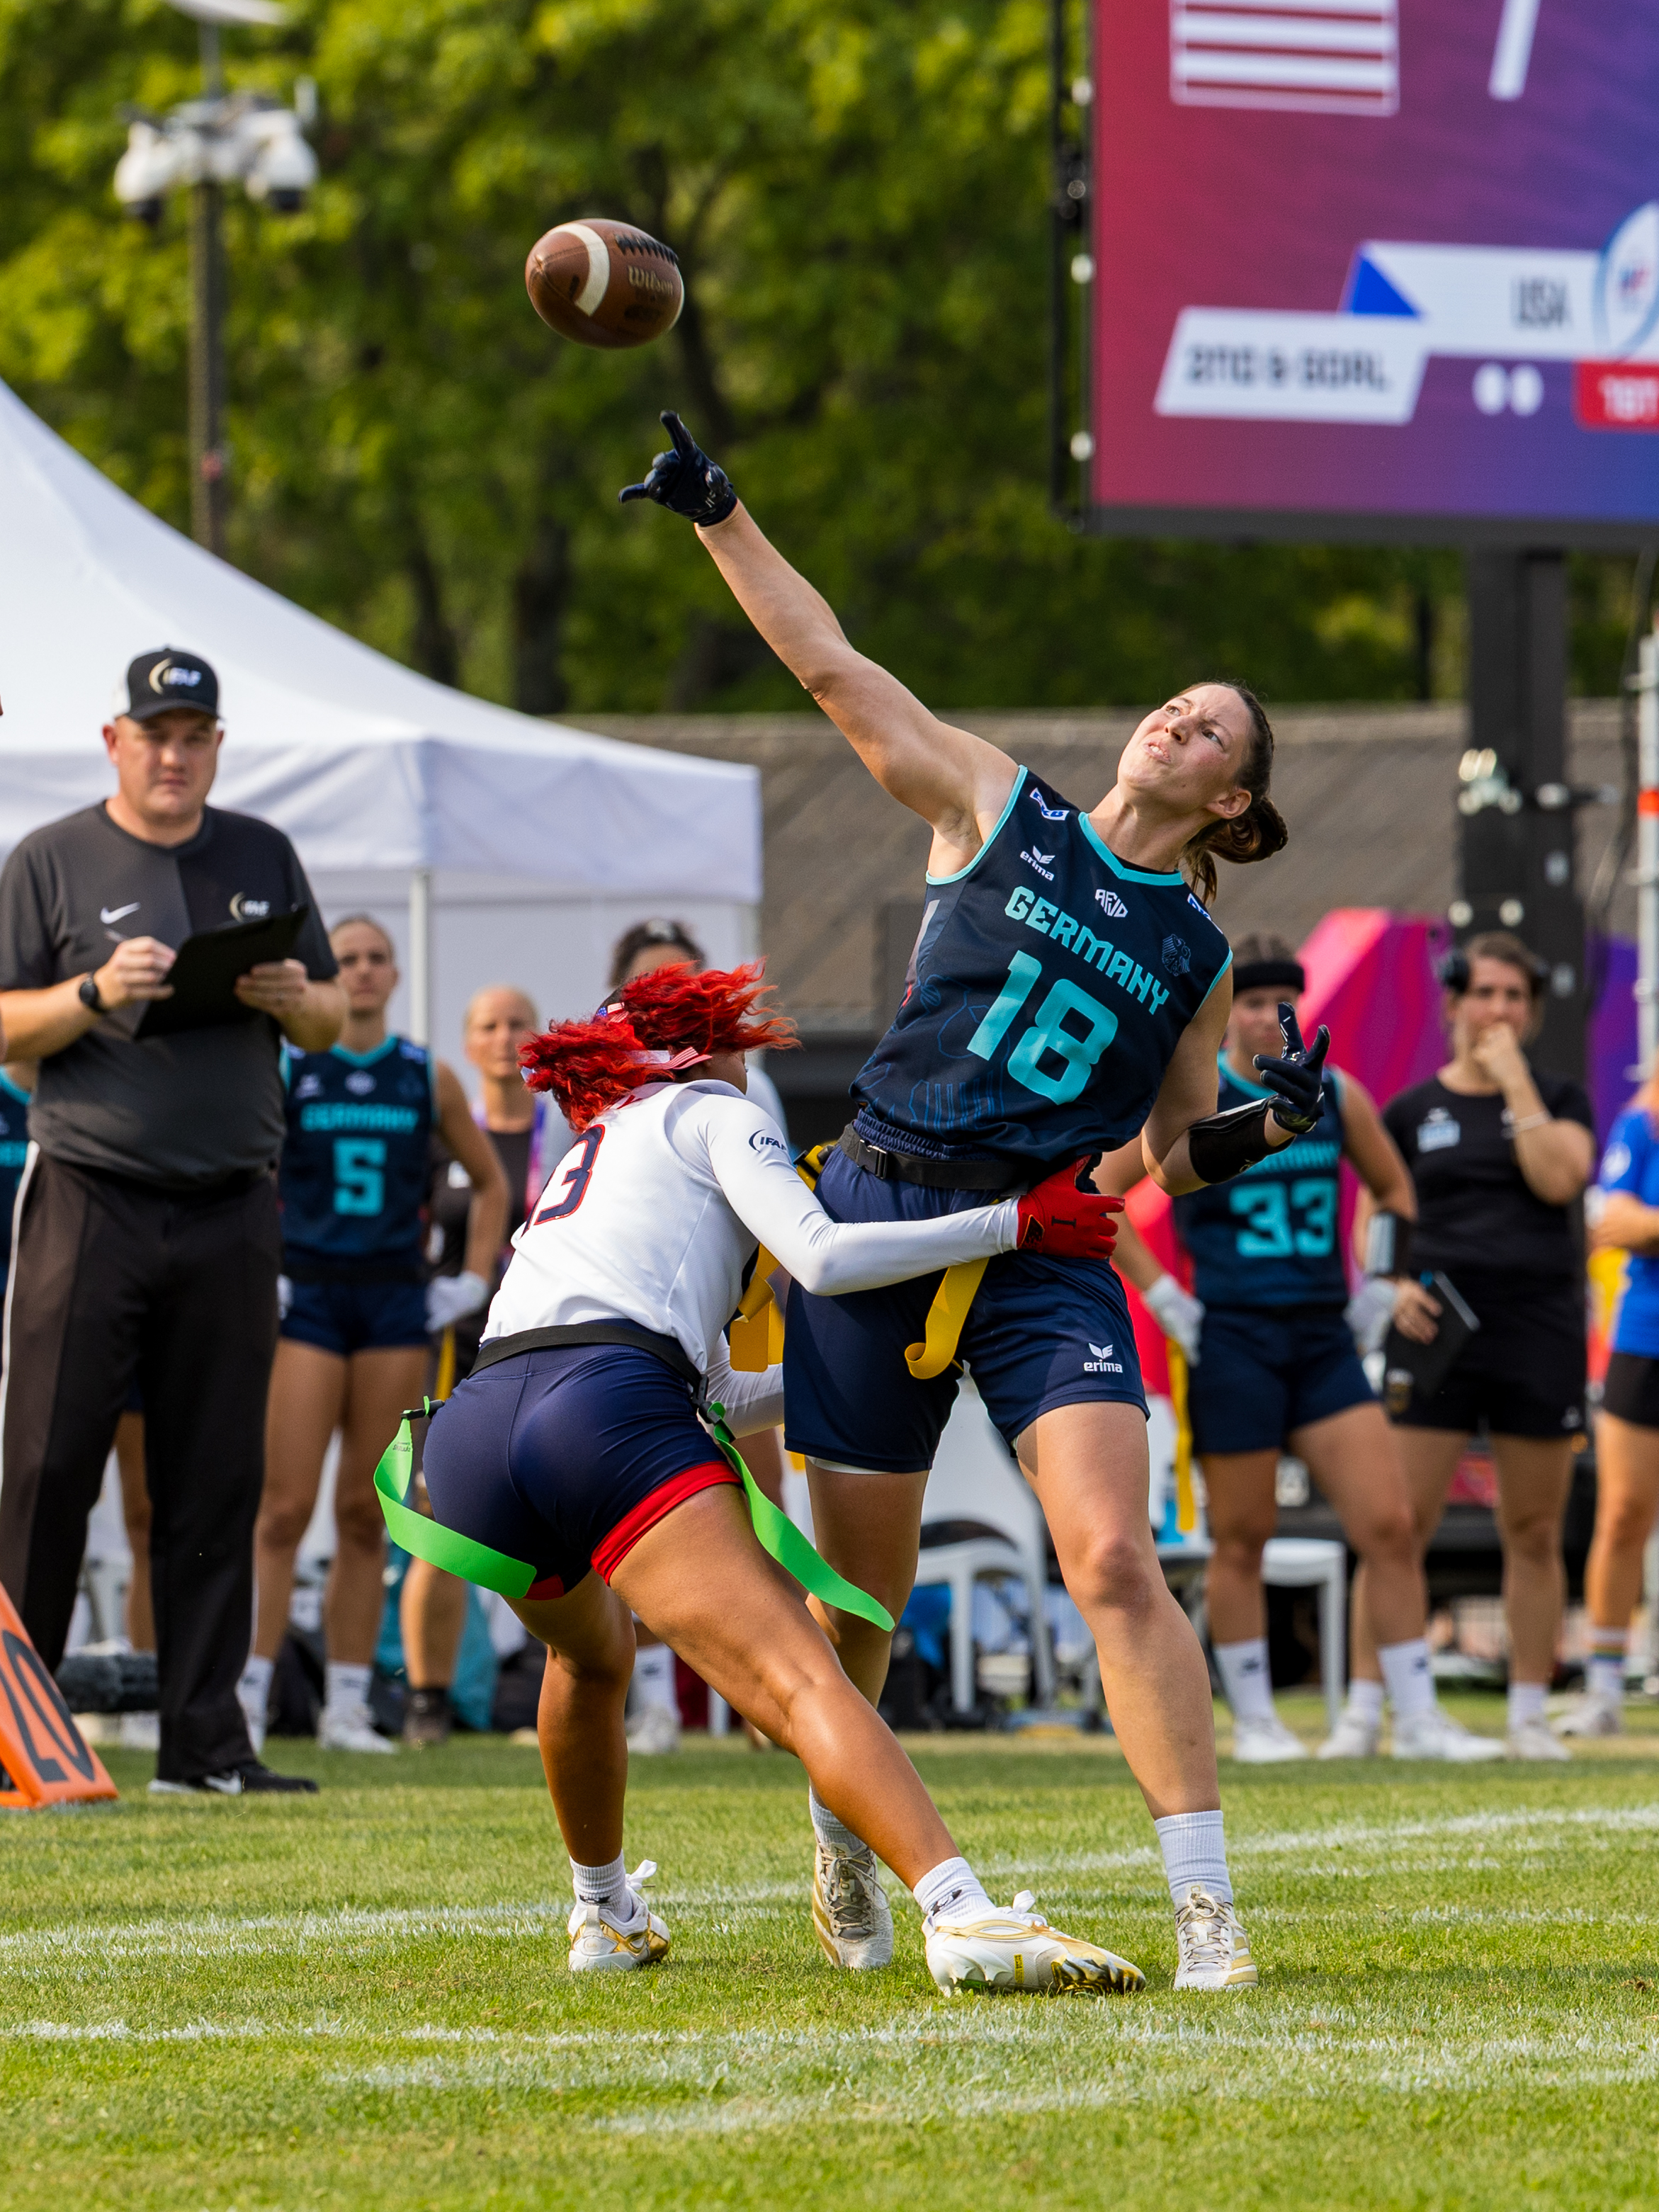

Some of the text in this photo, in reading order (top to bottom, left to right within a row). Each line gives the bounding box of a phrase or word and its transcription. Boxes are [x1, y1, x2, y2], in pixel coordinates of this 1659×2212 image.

[1020, 850, 1055, 881] erima
[1004, 886, 1170, 1015] GERMANY
[966, 950, 1119, 1106] 18
[333, 1137, 386, 1217] 5
[521, 1123, 606, 1240] 3
[1228, 1176, 1337, 1258] 33
[1083, 1359, 1123, 1373] erima
